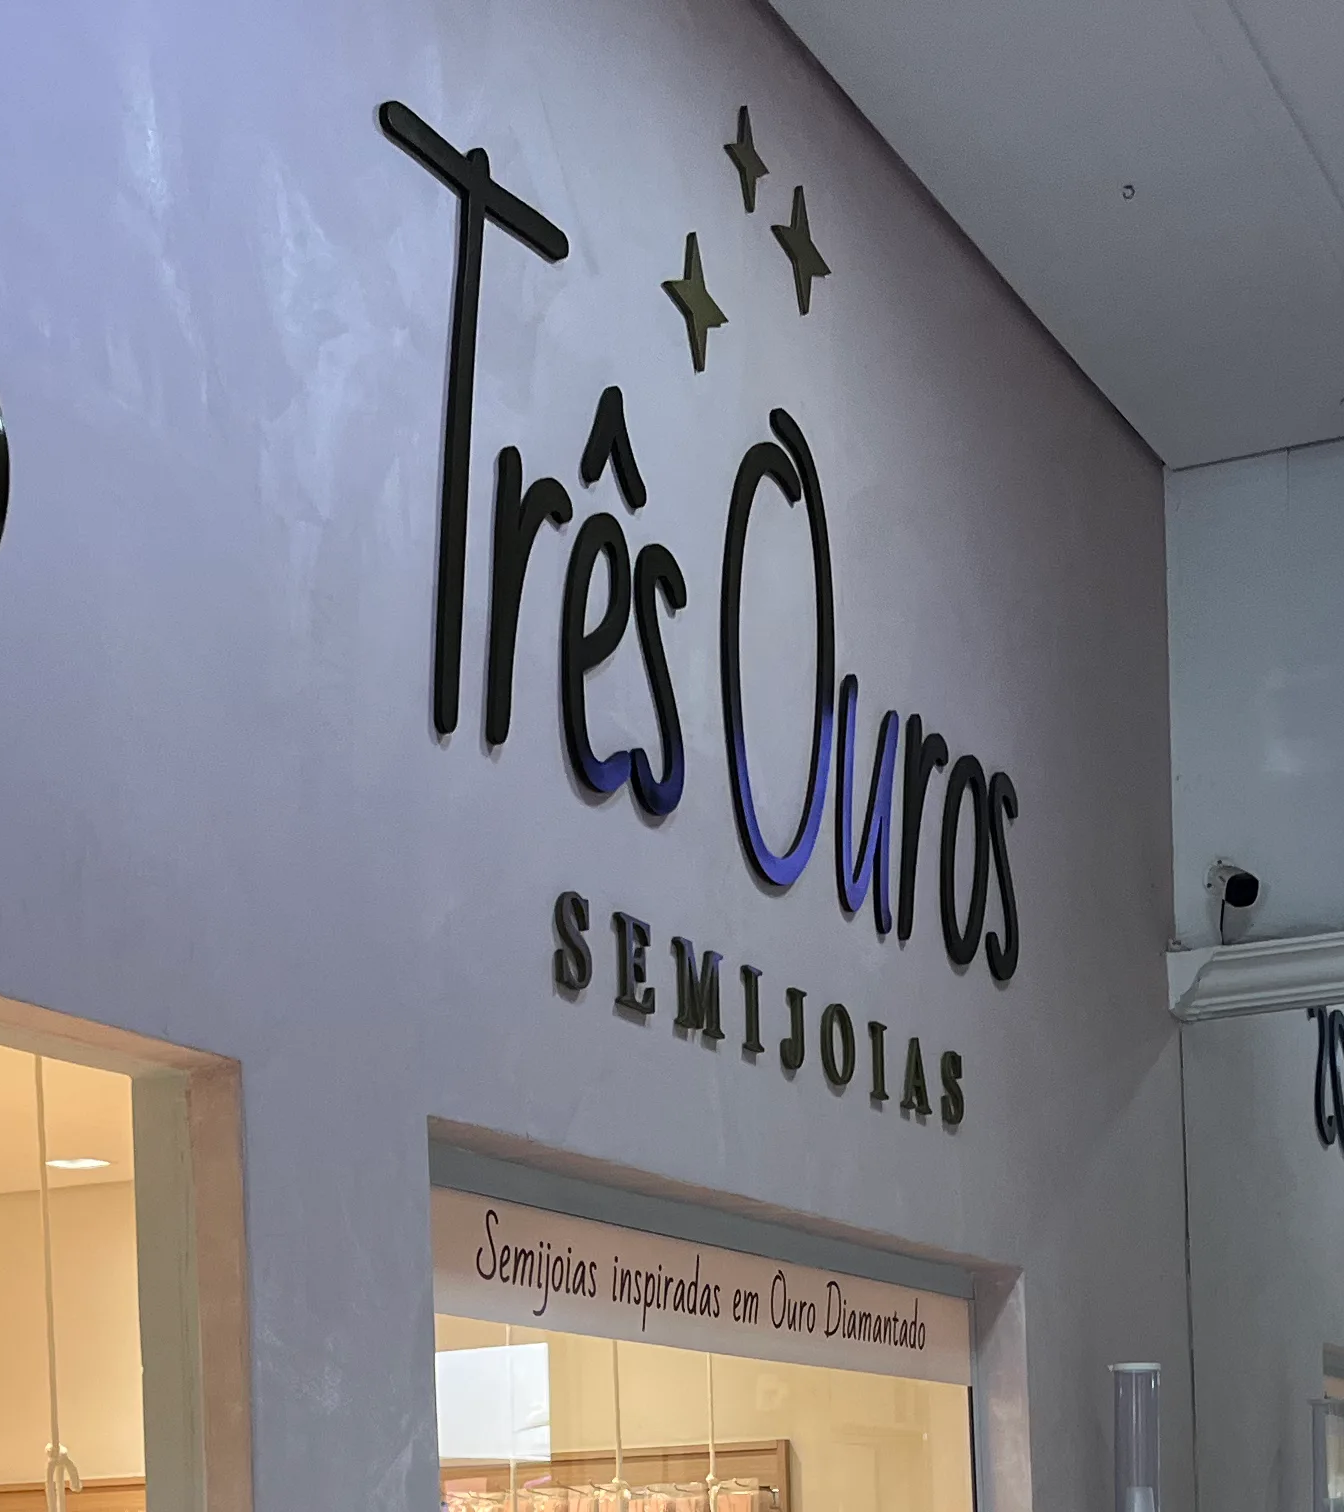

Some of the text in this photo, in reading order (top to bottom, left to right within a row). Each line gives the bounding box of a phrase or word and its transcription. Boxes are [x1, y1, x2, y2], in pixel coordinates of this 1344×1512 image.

[378, 100, 1020, 981] Três Ouros
[553, 891, 966, 1125] SEMIJOIAS
[475, 1208, 927, 1352] Semijoias inspiradas em Ouro Diamantado
